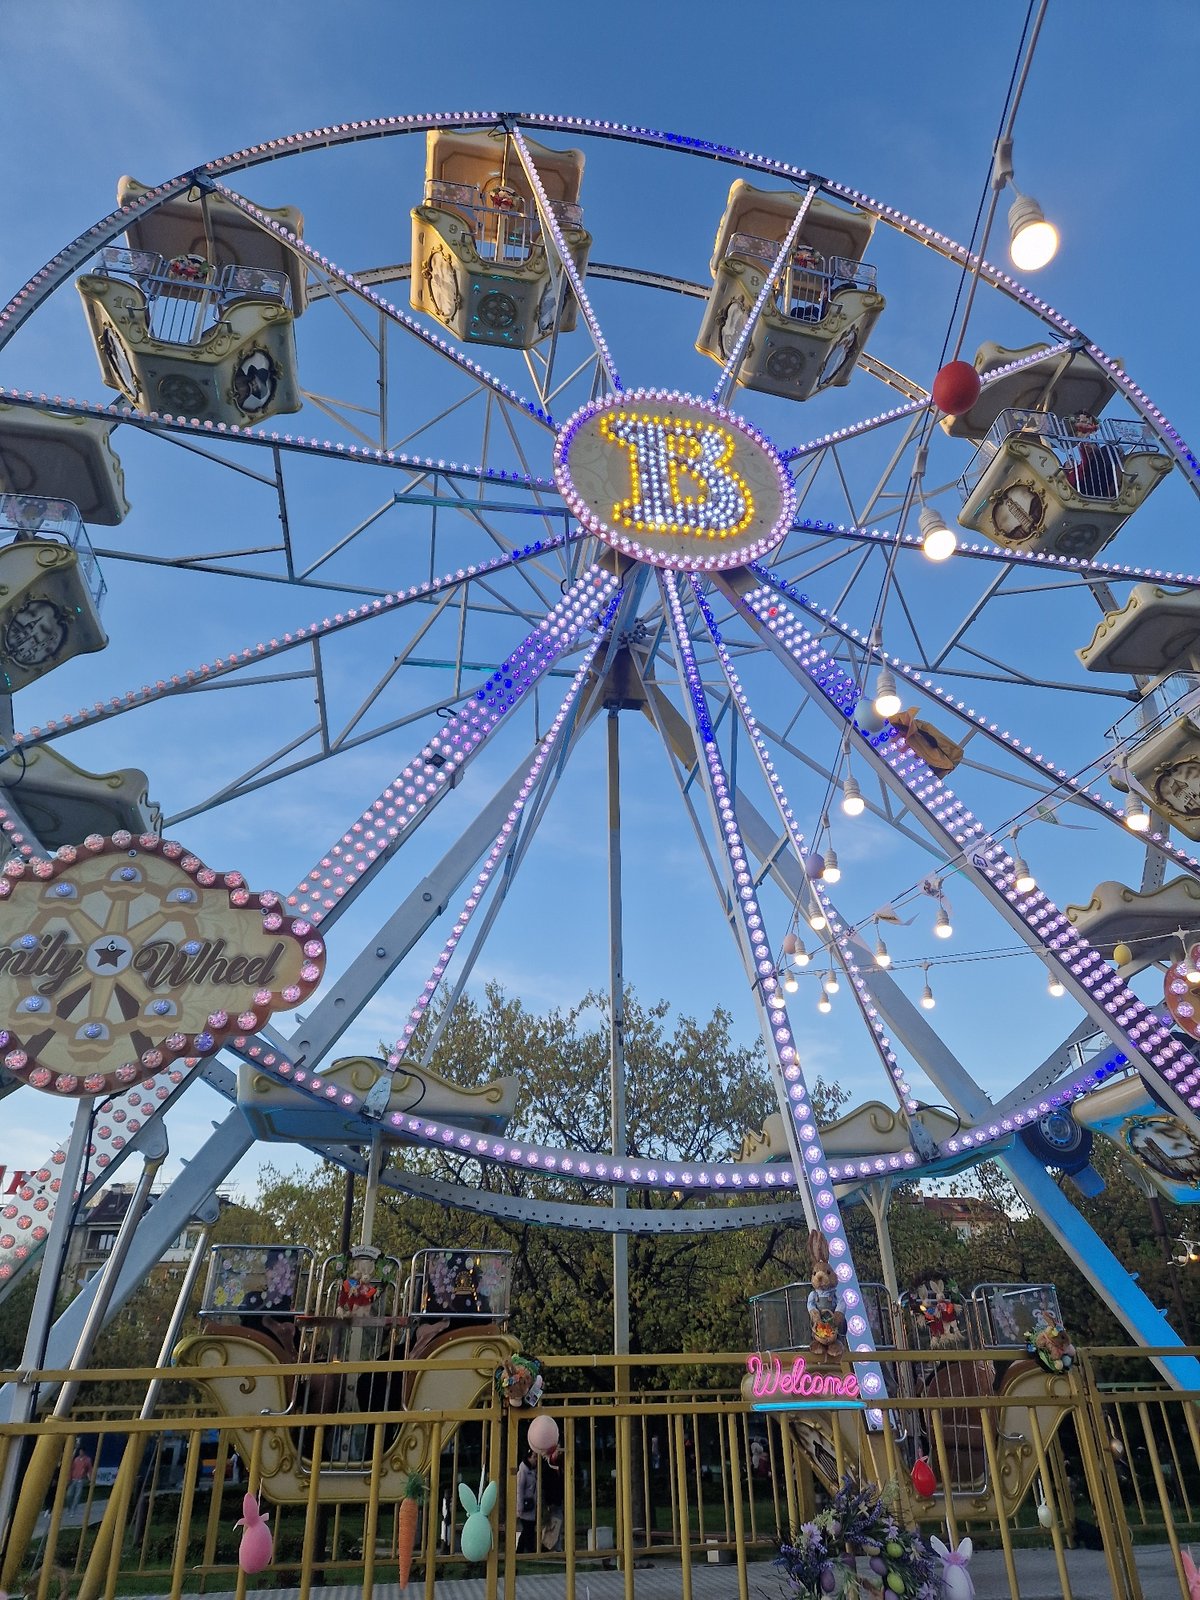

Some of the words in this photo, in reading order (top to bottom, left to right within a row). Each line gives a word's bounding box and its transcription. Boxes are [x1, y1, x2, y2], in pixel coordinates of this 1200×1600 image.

[1038, 455, 1048, 468] 7
[132, 938, 285, 989] Wheel
[747, 1354, 861, 1398] Welcome
